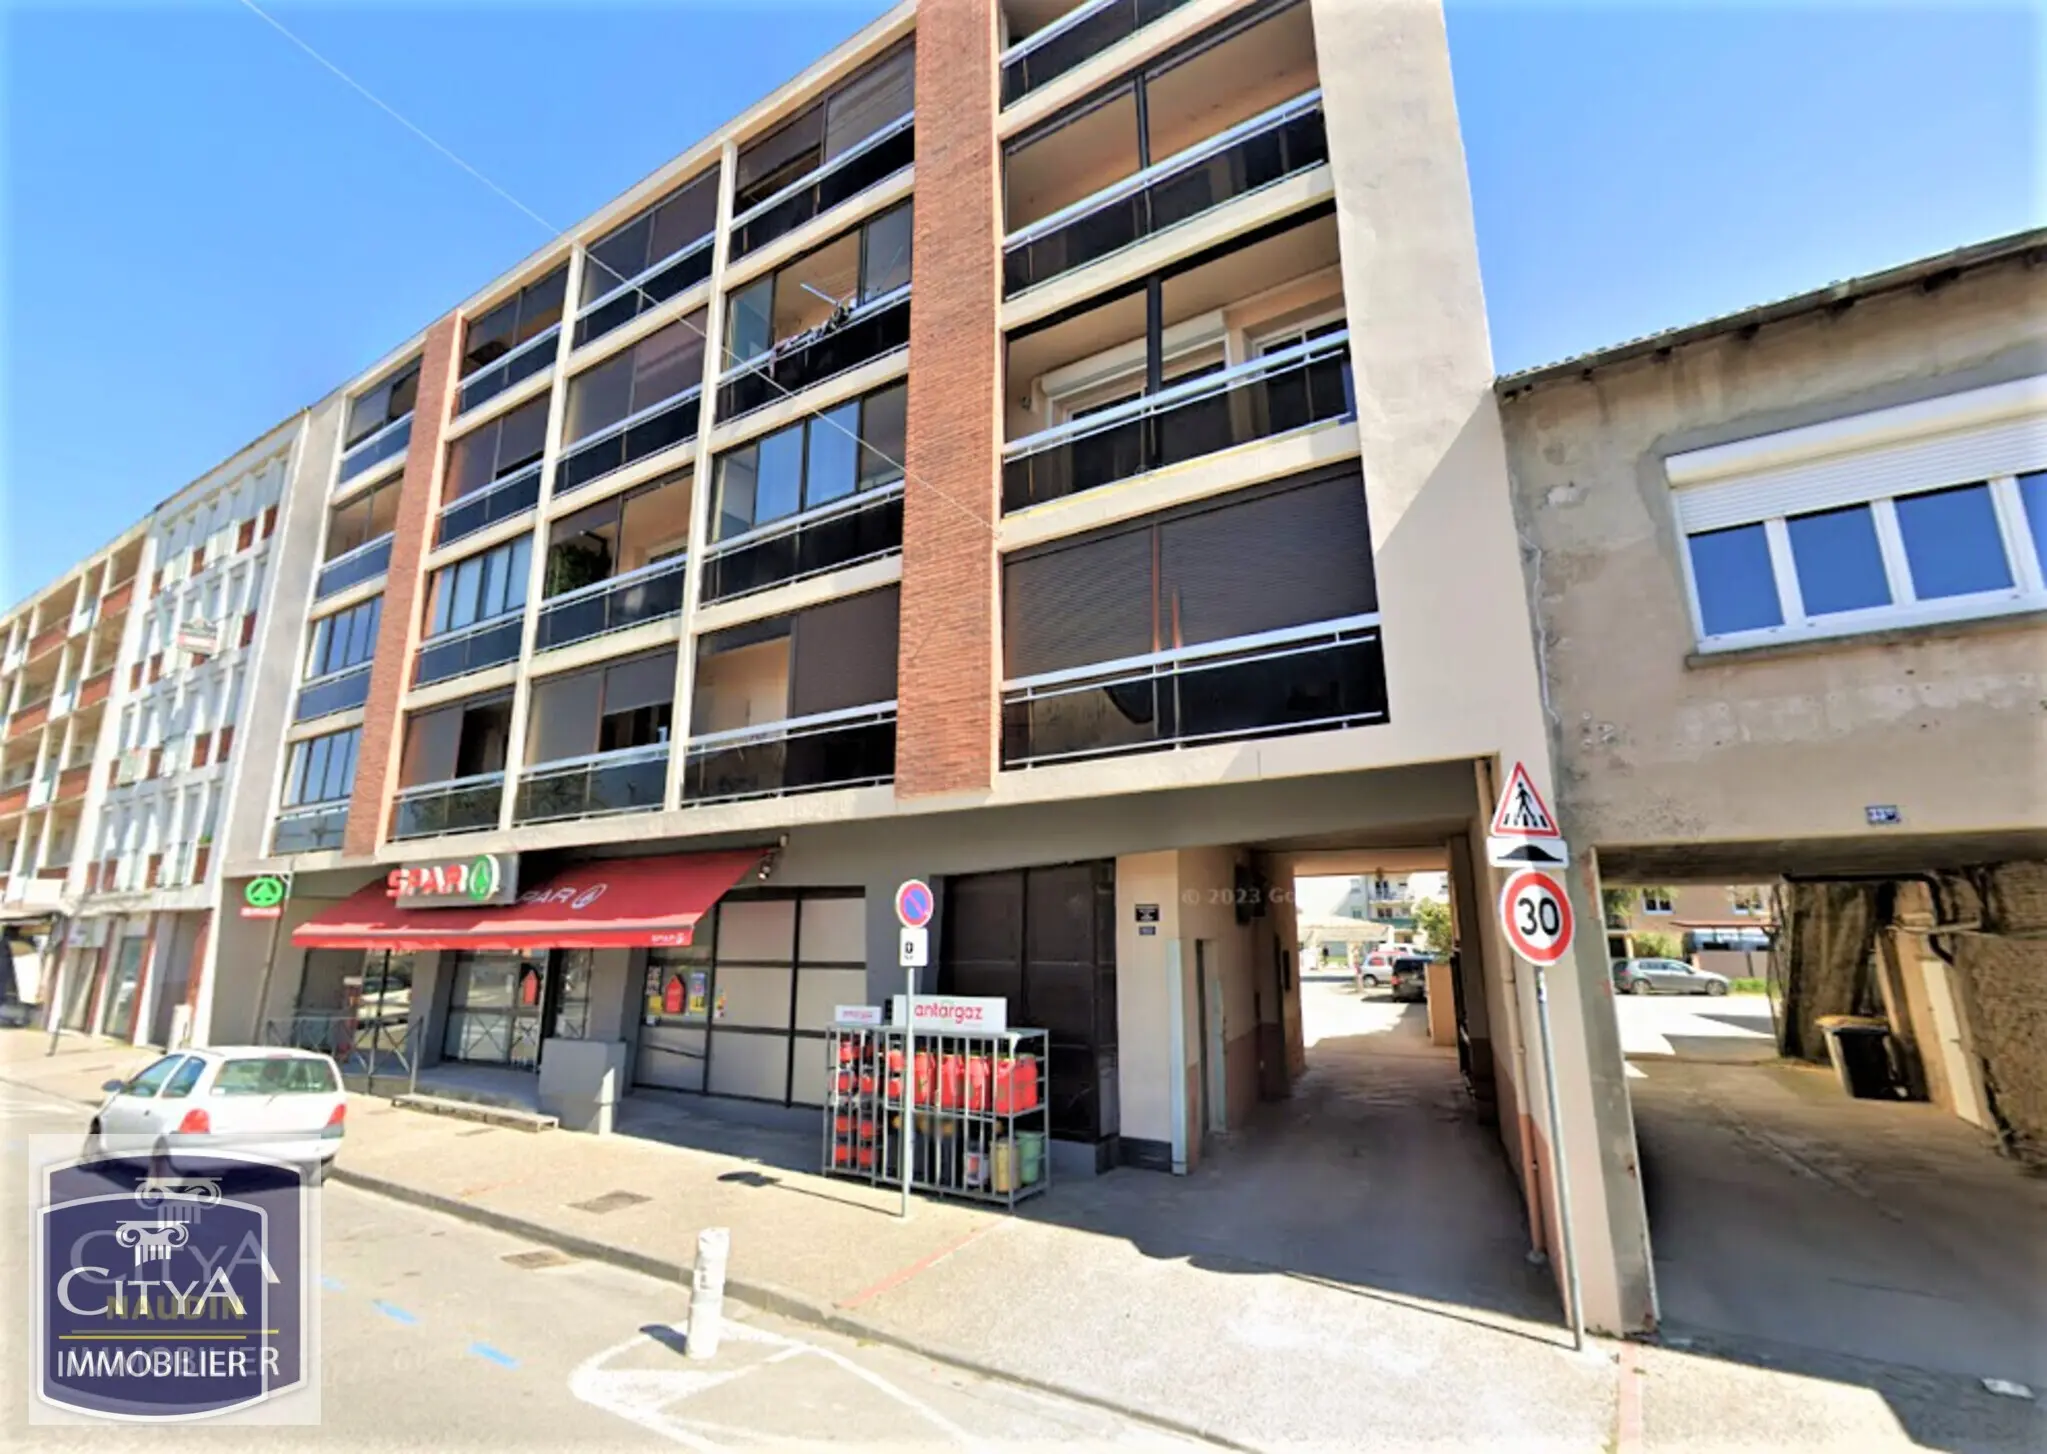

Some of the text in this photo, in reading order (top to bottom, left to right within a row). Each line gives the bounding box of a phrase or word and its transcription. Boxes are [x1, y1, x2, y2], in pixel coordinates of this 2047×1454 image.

[386, 864, 468, 897] SPAR
[517, 886, 578, 904] PAR
[1518, 897, 1560, 936] 30
[914, 1002, 984, 1024] antargaz
